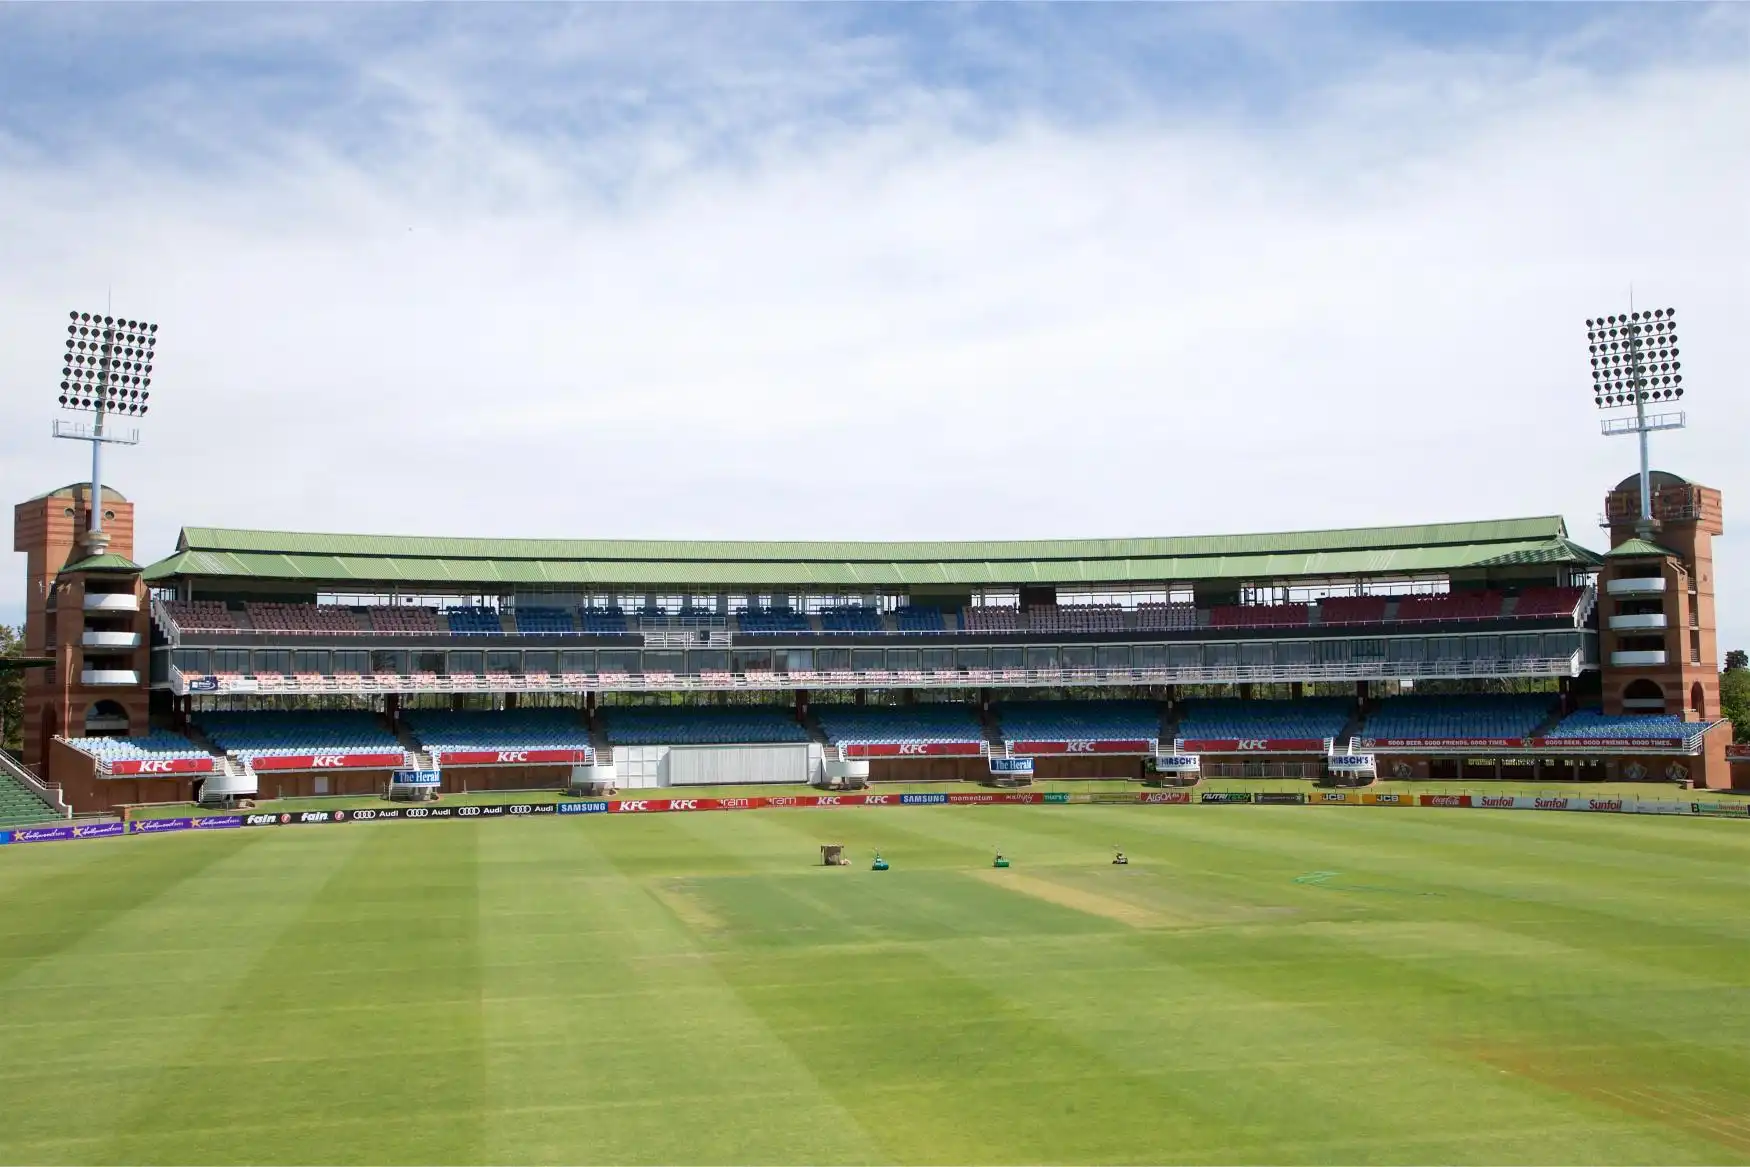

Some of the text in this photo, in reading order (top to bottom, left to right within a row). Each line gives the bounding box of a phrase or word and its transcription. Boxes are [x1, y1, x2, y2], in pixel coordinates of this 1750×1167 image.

[899, 743, 929, 754] KFC
[1066, 741, 1096, 752] KFC
[1238, 739, 1268, 750] KFC
[312, 755, 345, 767] KFC
[497, 751, 528, 762] KFC
[1161, 757, 1197, 765] HIRSCH'S
[1332, 756, 1369, 765] HIRSCH'S
[138, 760, 175, 772] KFC
[995, 759, 1032, 770] The Herald
[399, 770, 440, 782] The Herald
[816, 796, 841, 805] KFC
[864, 795, 889, 804] KFC
[903, 794, 945, 803] SAMSUNG
[1323, 793, 1346, 801] JCB
[1377, 794, 1400, 802] JCB
[1481, 796, 1514, 807] Sunfoil
[561, 802, 606, 812] SAMSUNG
[619, 800, 648, 811] KFC
[670, 799, 698, 809] KFC
[1534, 798, 1568, 809] Sunfoil
[1589, 799, 1622, 811] Sunfoil
[379, 809, 399, 817] Audi
[432, 808, 451, 816] Audi
[484, 806, 502, 814] Audi
[534, 805, 553, 813] Audi
